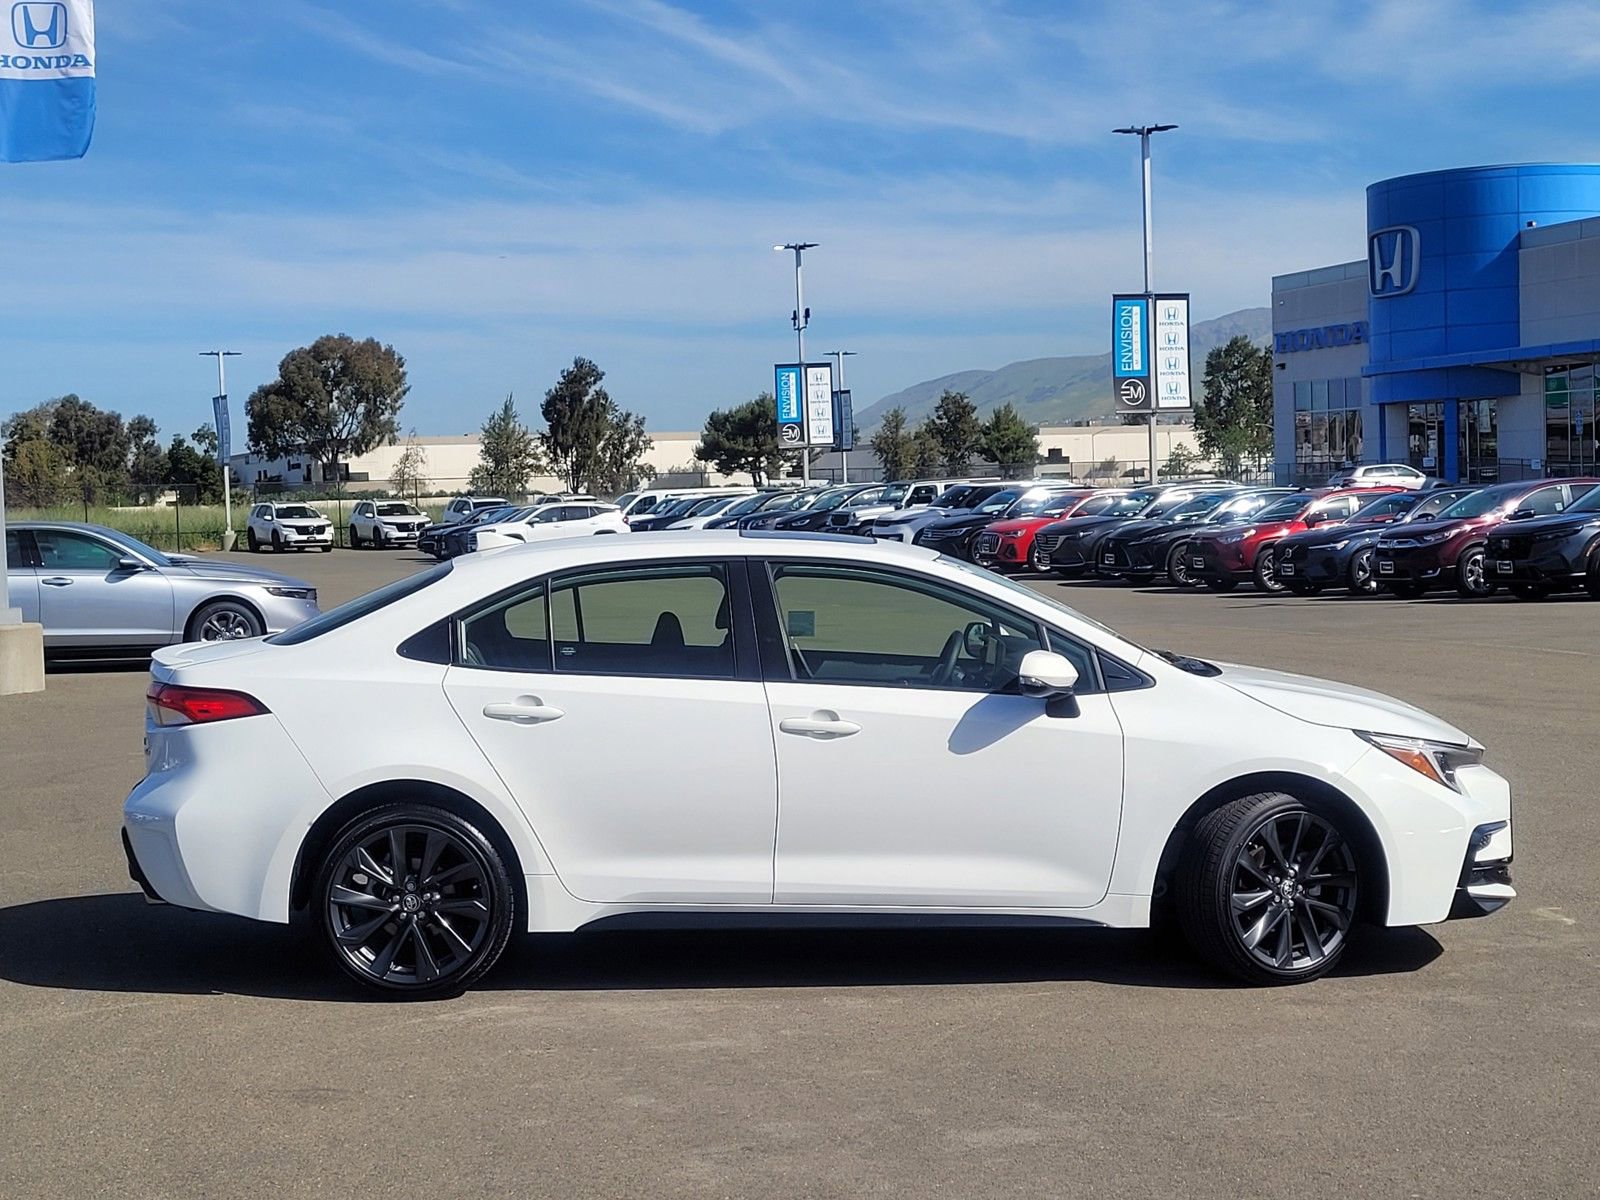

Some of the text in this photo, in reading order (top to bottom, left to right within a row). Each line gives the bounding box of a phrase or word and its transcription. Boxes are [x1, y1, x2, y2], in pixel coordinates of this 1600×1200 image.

[1120, 306, 1132, 370] ENVISION
[1274, 322, 1368, 353] HONDA
[781, 372, 790, 418] ENVISION
